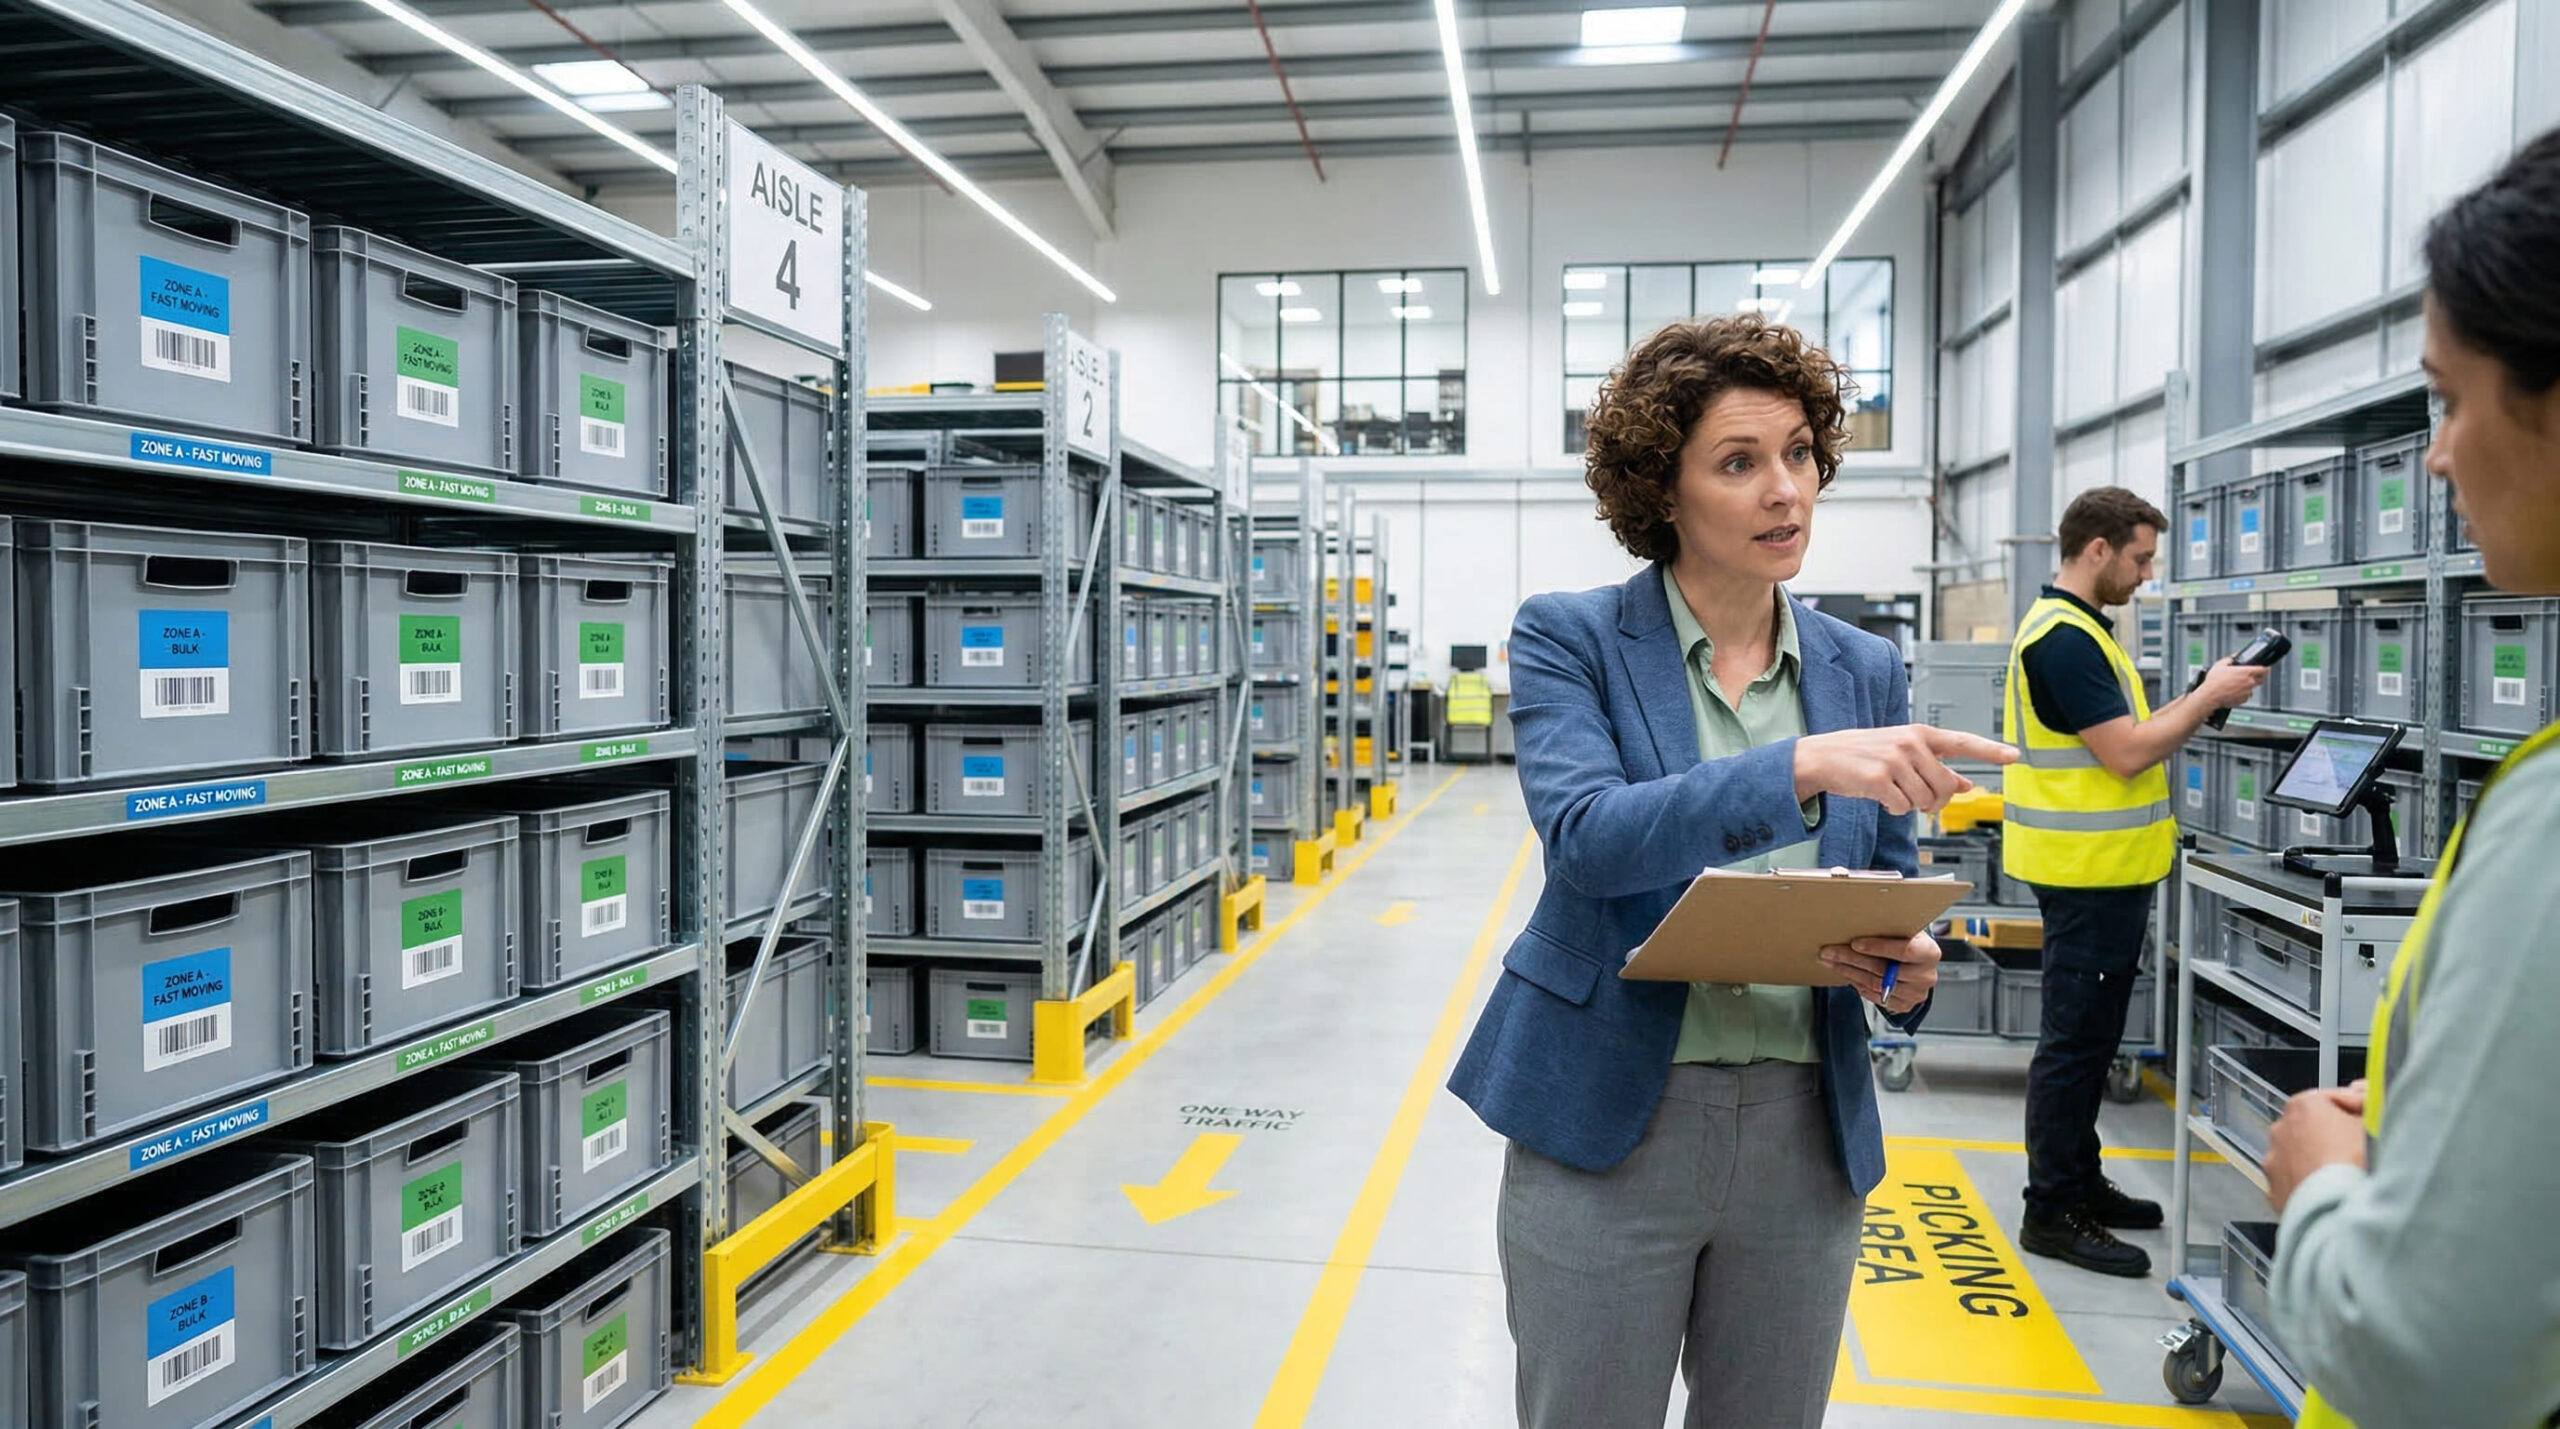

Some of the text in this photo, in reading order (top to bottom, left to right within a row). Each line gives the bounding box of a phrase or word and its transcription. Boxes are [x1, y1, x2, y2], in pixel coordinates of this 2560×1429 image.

[751, 161, 823, 235] AISLE
[776, 239, 800, 310] 4
[163, 279, 192, 298] ZONE
[194, 287, 202, 298] A
[151, 292, 221, 319] FAST MOVING
[1083, 390, 1093, 438] 2
[140, 439, 173, 457] ZONE
[175, 445, 184, 458] A
[192, 447, 220, 463] FAST
[222, 450, 263, 469] MOVING
[163, 627, 191, 640] ZONE
[192, 628, 201, 640] A
[171, 643, 200, 655] BULK
[135, 796, 167, 813] ZONE
[169, 795, 178, 808] A
[186, 791, 213, 806] FAST
[215, 786, 256, 803] MOVING
[164, 971, 193, 989] ZONE
[194, 969, 203, 981] A
[153, 980, 222, 1006] FAST MOVING
[1180, 1104, 1305, 1120] ONE WAY
[1183, 1116, 1294, 1131] TRAFFIC
[141, 1140, 172, 1162] ZONE
[174, 1136, 183, 1150] A
[191, 1123, 217, 1144] FAST
[219, 1108, 259, 1133] MOVING
[1902, 1183, 2029, 1318] PICKING
[169, 1297, 200, 1321] ZONE
[200, 1295, 209, 1307] B
[178, 1310, 207, 1332] BULK
